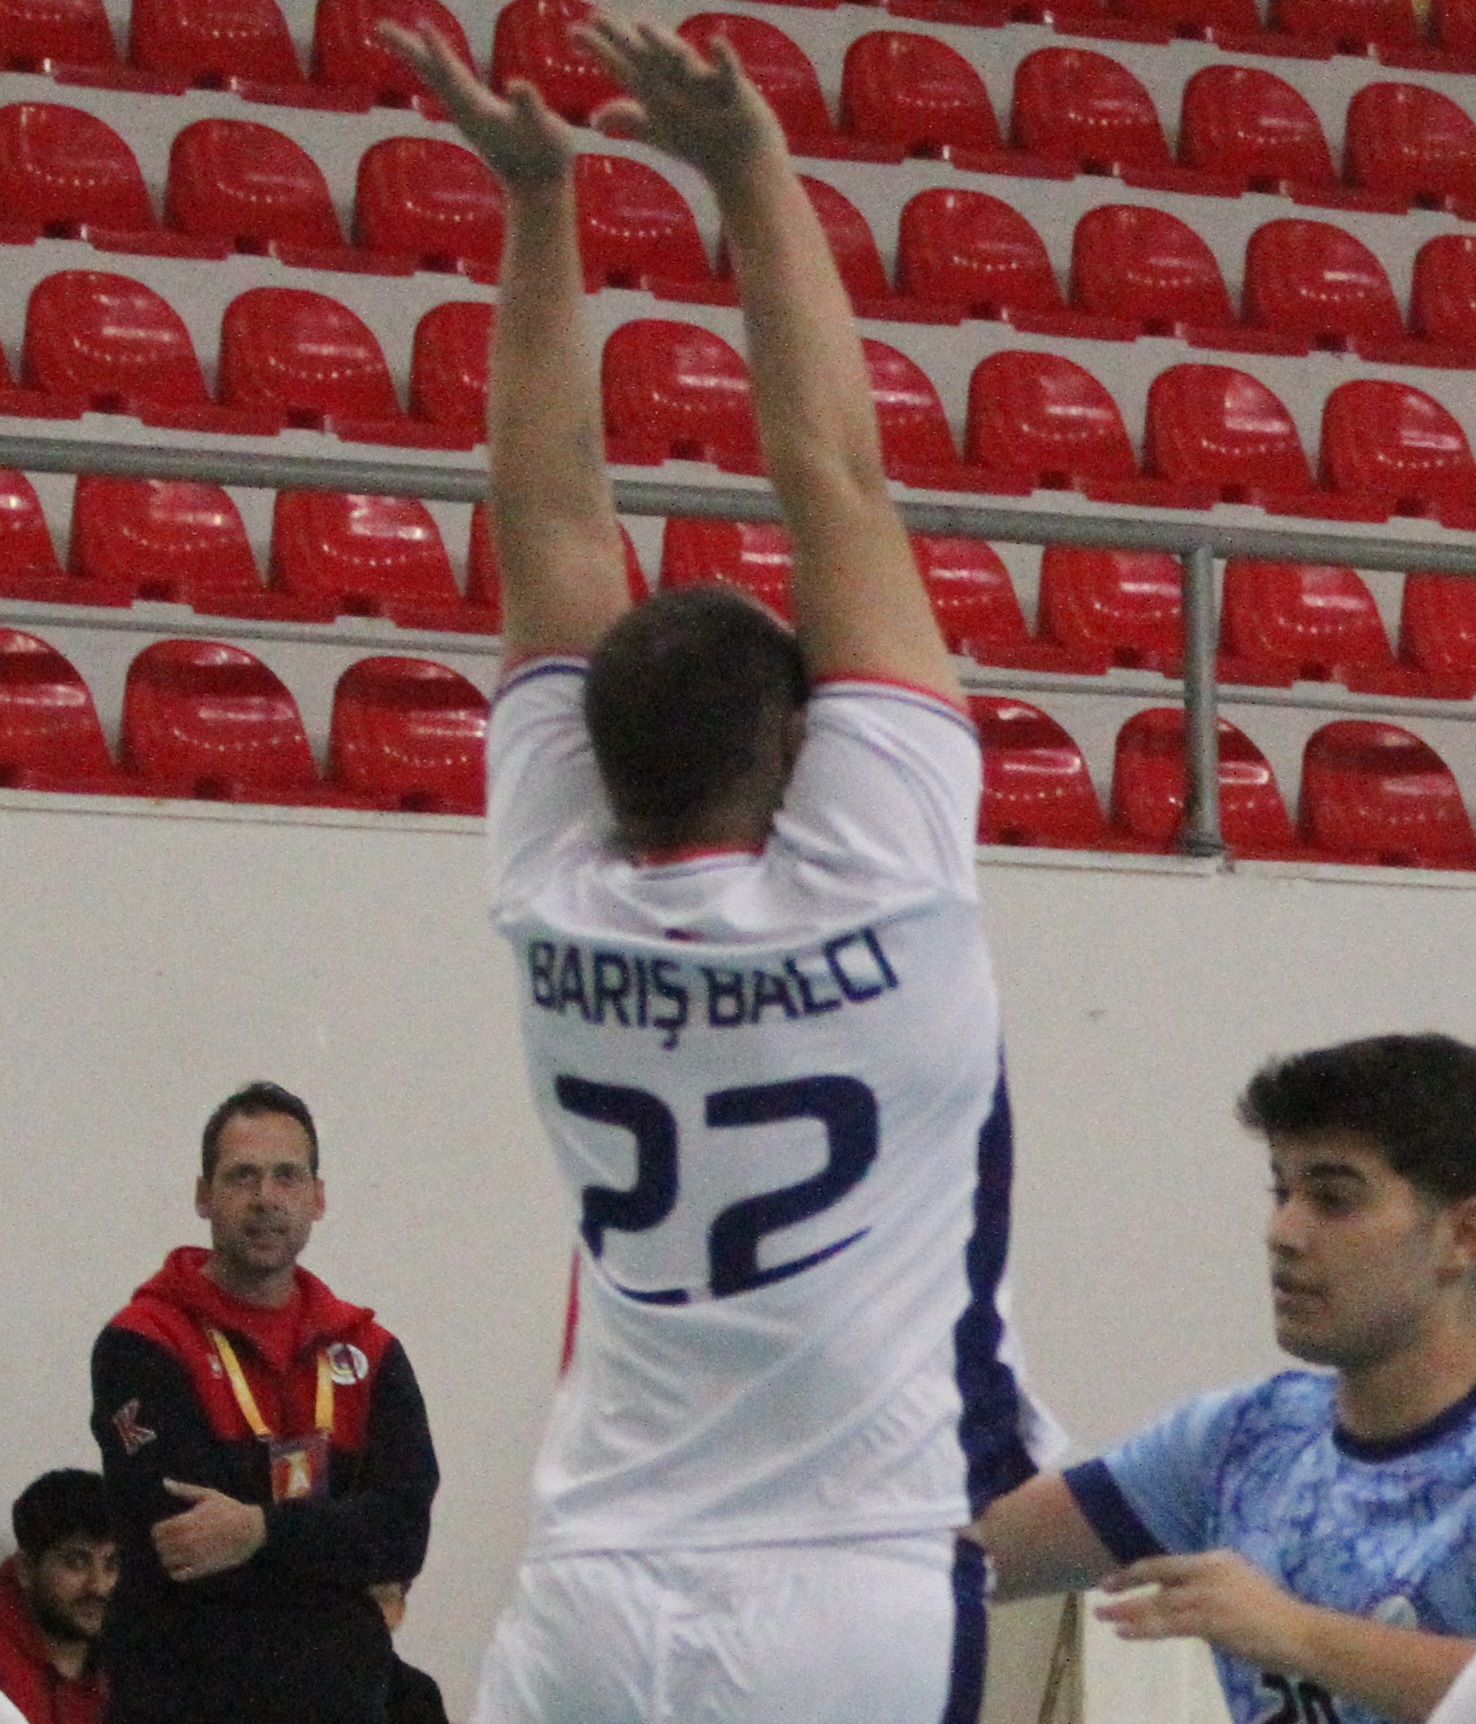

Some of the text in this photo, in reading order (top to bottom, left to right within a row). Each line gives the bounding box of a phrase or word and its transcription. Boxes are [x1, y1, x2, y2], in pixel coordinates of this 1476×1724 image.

[528, 926, 900, 1050] BARIŞ BALCI
[554, 1073, 881, 1308] 22
